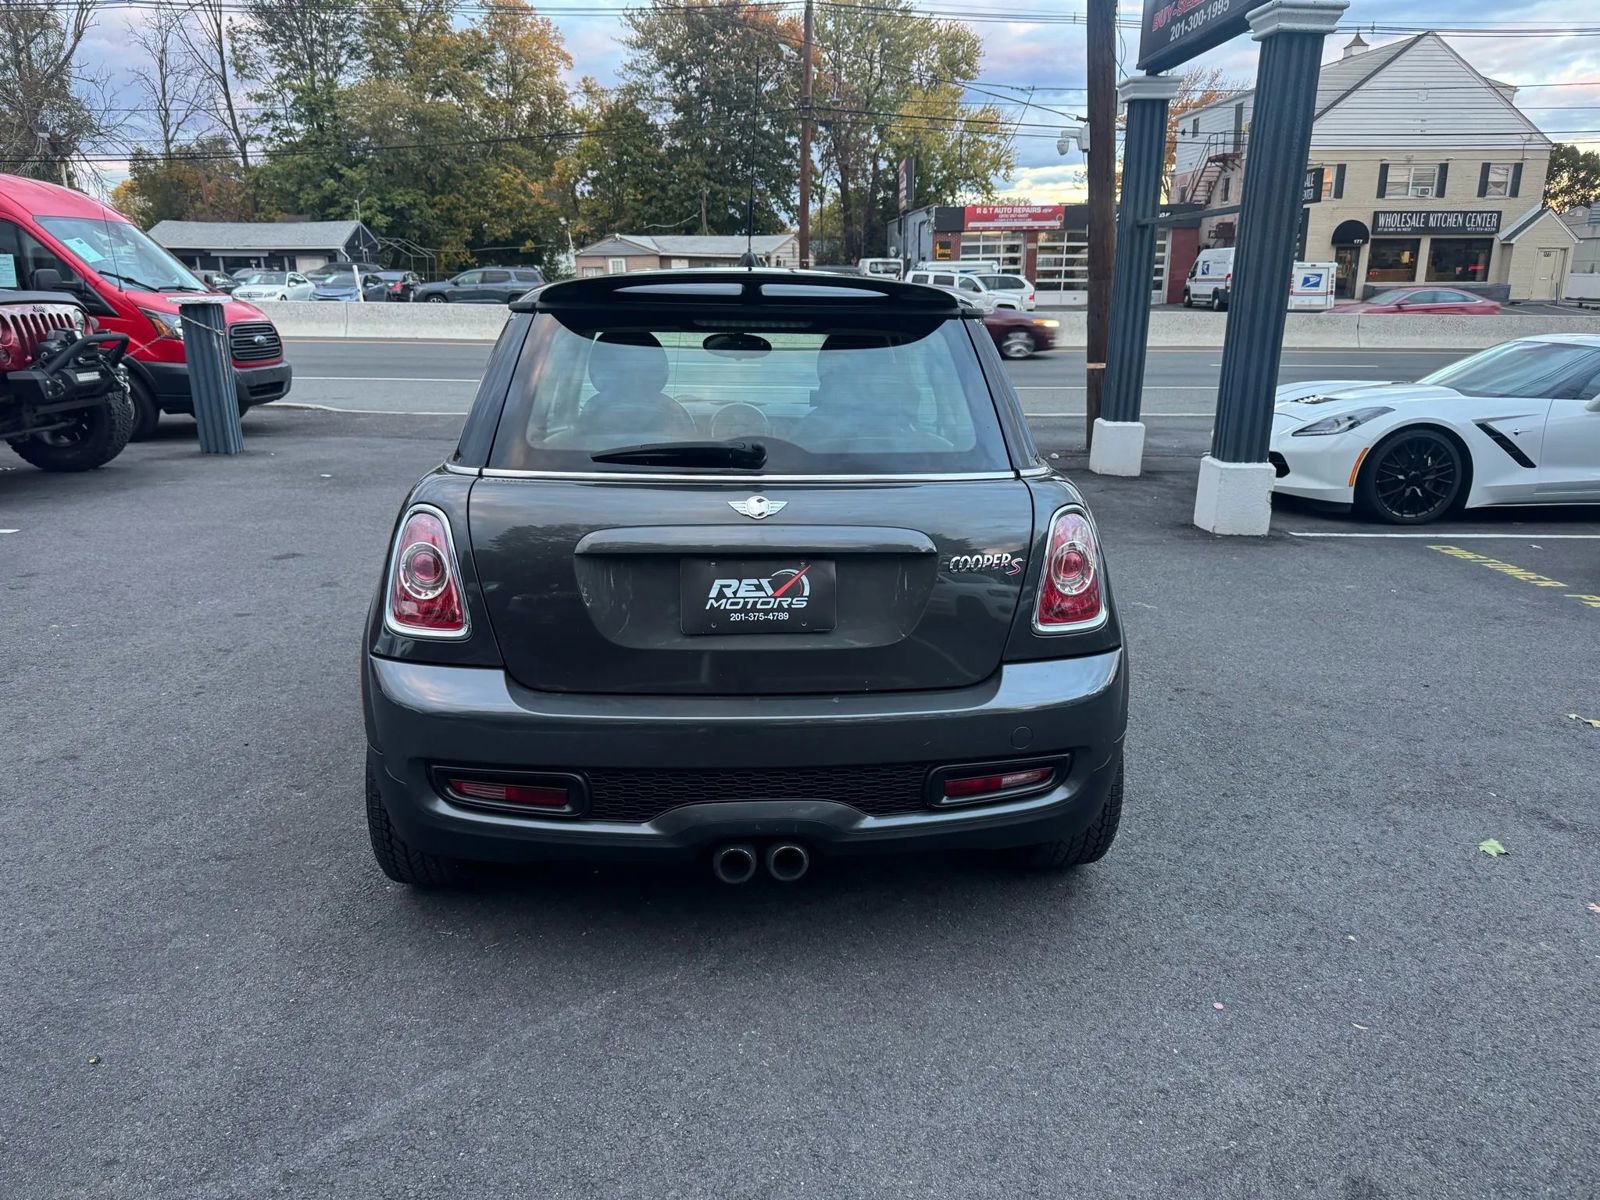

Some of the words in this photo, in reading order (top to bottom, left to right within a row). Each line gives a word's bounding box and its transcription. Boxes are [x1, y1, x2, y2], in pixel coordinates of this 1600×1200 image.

[976, 207, 981, 215] R
[1013, 206, 1041, 214] REPAIRS
[1378, 212, 1426, 228] WHOLESALE
[1428, 212, 1464, 228] KITCHEN
[1466, 212, 1498, 228] CENTER
[949, 553, 1012, 573] COOPER
[1005, 557, 1023, 576] S
[1426, 544, 1569, 587] CUSTOMER
[708, 571, 806, 598] REV
[705, 597, 809, 610] MOTORS
[729, 612, 790, 621] 201-375-4789
